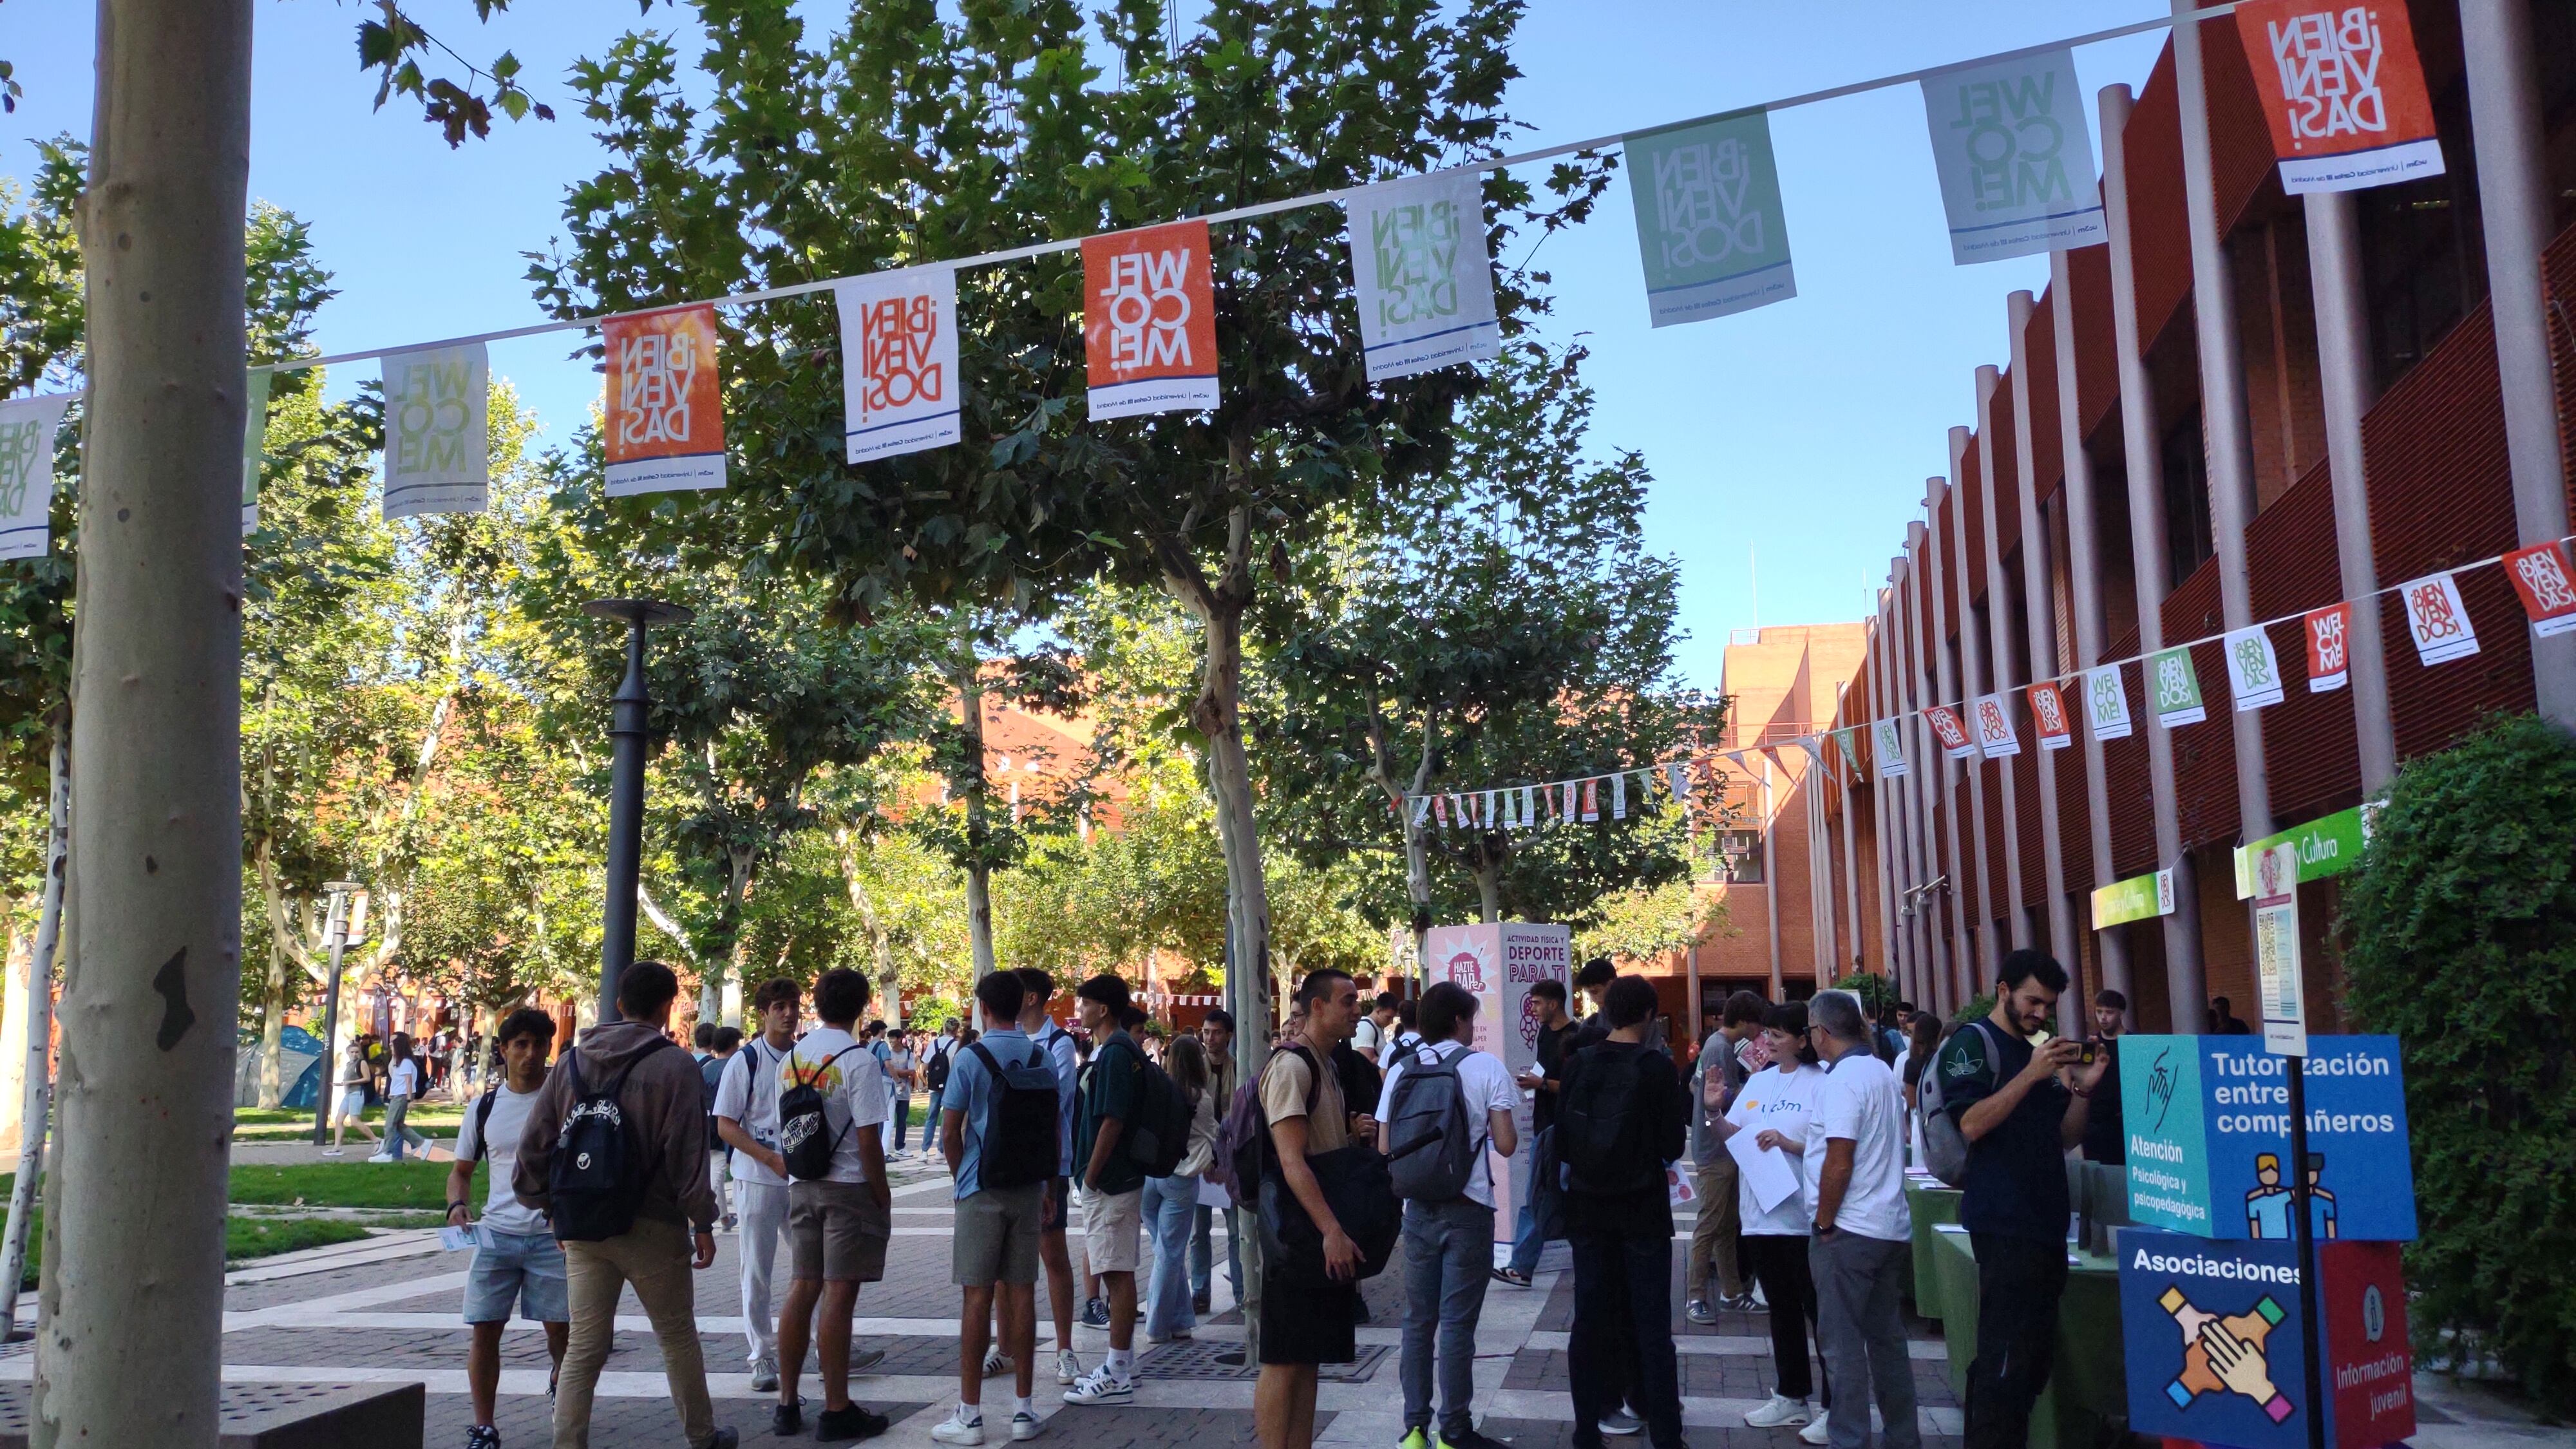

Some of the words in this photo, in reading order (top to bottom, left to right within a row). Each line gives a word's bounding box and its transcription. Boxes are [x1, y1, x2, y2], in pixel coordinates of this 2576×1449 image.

[2410, 580, 2445, 609] ¡BIEN
[2414, 599, 2453, 624] VENI
[2312, 611, 2344, 638] WEL
[2417, 618, 2463, 643] DOS!
[2316, 628, 2342, 653] CO
[2093, 673, 2117, 692] WEL
[2094, 690, 2116, 708] CO
[2098, 701, 2121, 723] ME!
[2295, 849, 2300, 876] y
[2302, 830, 2337, 864] Cultura
[1540, 935, 1559, 943] FÍSICA
[1509, 945, 1565, 961] DEPORTE
[1454, 961, 1475, 973] HAZTE
[1509, 962, 1549, 983] PARA
[1551, 964, 1566, 983] TI
[2211, 1052, 2389, 1076] Tutorzación
[2215, 1081, 2289, 1104] entre
[2131, 1133, 2183, 1164] Atención
[2132, 1165, 2180, 1191] Psicológica
[2181, 1178, 2186, 1195] y
[2134, 1191, 2206, 1220] psicopedagógica
[2337, 1350, 2404, 1390] Información
[2370, 1382, 2407, 1422] juvenil
